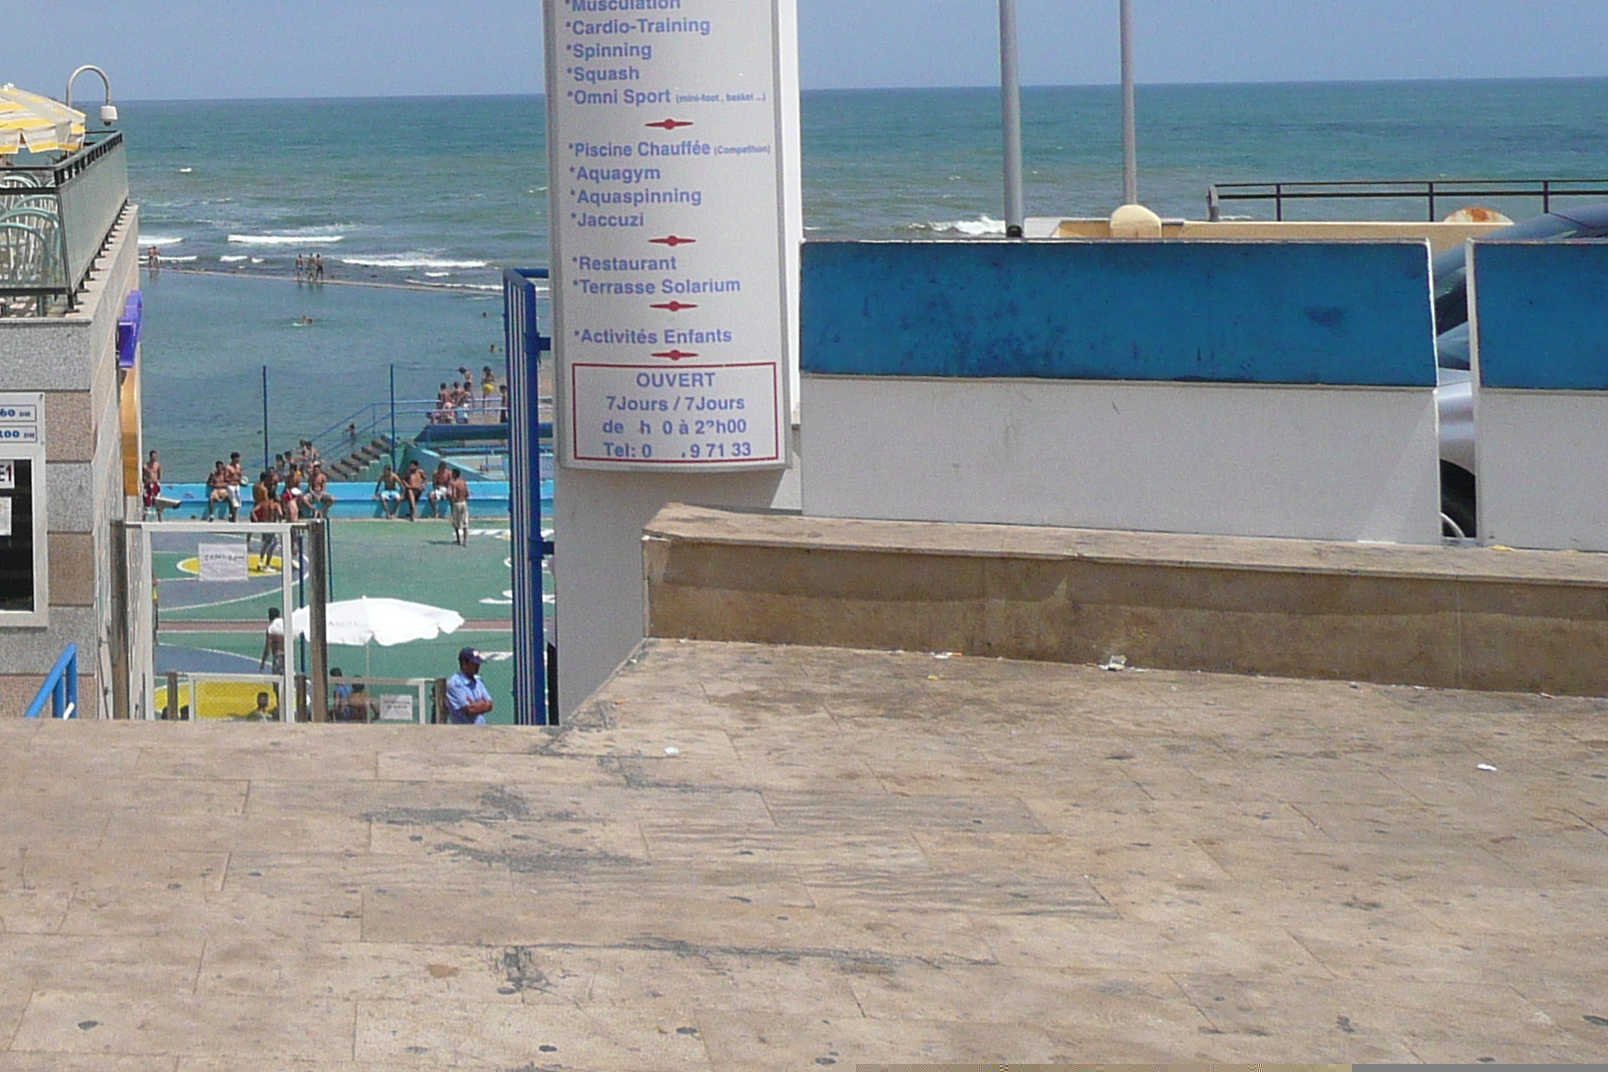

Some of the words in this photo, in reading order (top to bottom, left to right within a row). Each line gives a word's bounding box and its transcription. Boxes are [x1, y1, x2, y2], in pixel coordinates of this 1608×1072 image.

[572, 17, 710, 36] Cardio-Training
[573, 42, 652, 61] Spinning
[573, 66, 640, 85] Squash
[574, 89, 618, 105] Omni
[624, 89, 671, 107] Sport
[574, 141, 632, 158] Piscine
[638, 140, 710, 156] Chauffée
[576, 166, 661, 184] Aquagym
[577, 188, 702, 208] Aquaspinning
[577, 212, 644, 228] Jaccuzi
[579, 256, 677, 271] Restaurant
[579, 279, 656, 295] Terrasse
[661, 278, 741, 294] Solarium
[581, 329, 658, 344] Activités
[664, 328, 732, 344] Enfants
[636, 372, 716, 388] OUVERT
[606, 395, 668, 411] 7Jours
[673, 396, 680, 410] /
[685, 396, 745, 411] 7Jours
[0, 408, 16, 418] 60
[603, 419, 624, 434] de
[679, 419, 689, 435] à
[603, 442, 636, 457] Tel:
[706, 443, 724, 457] 71
[732, 442, 751, 457] 33
